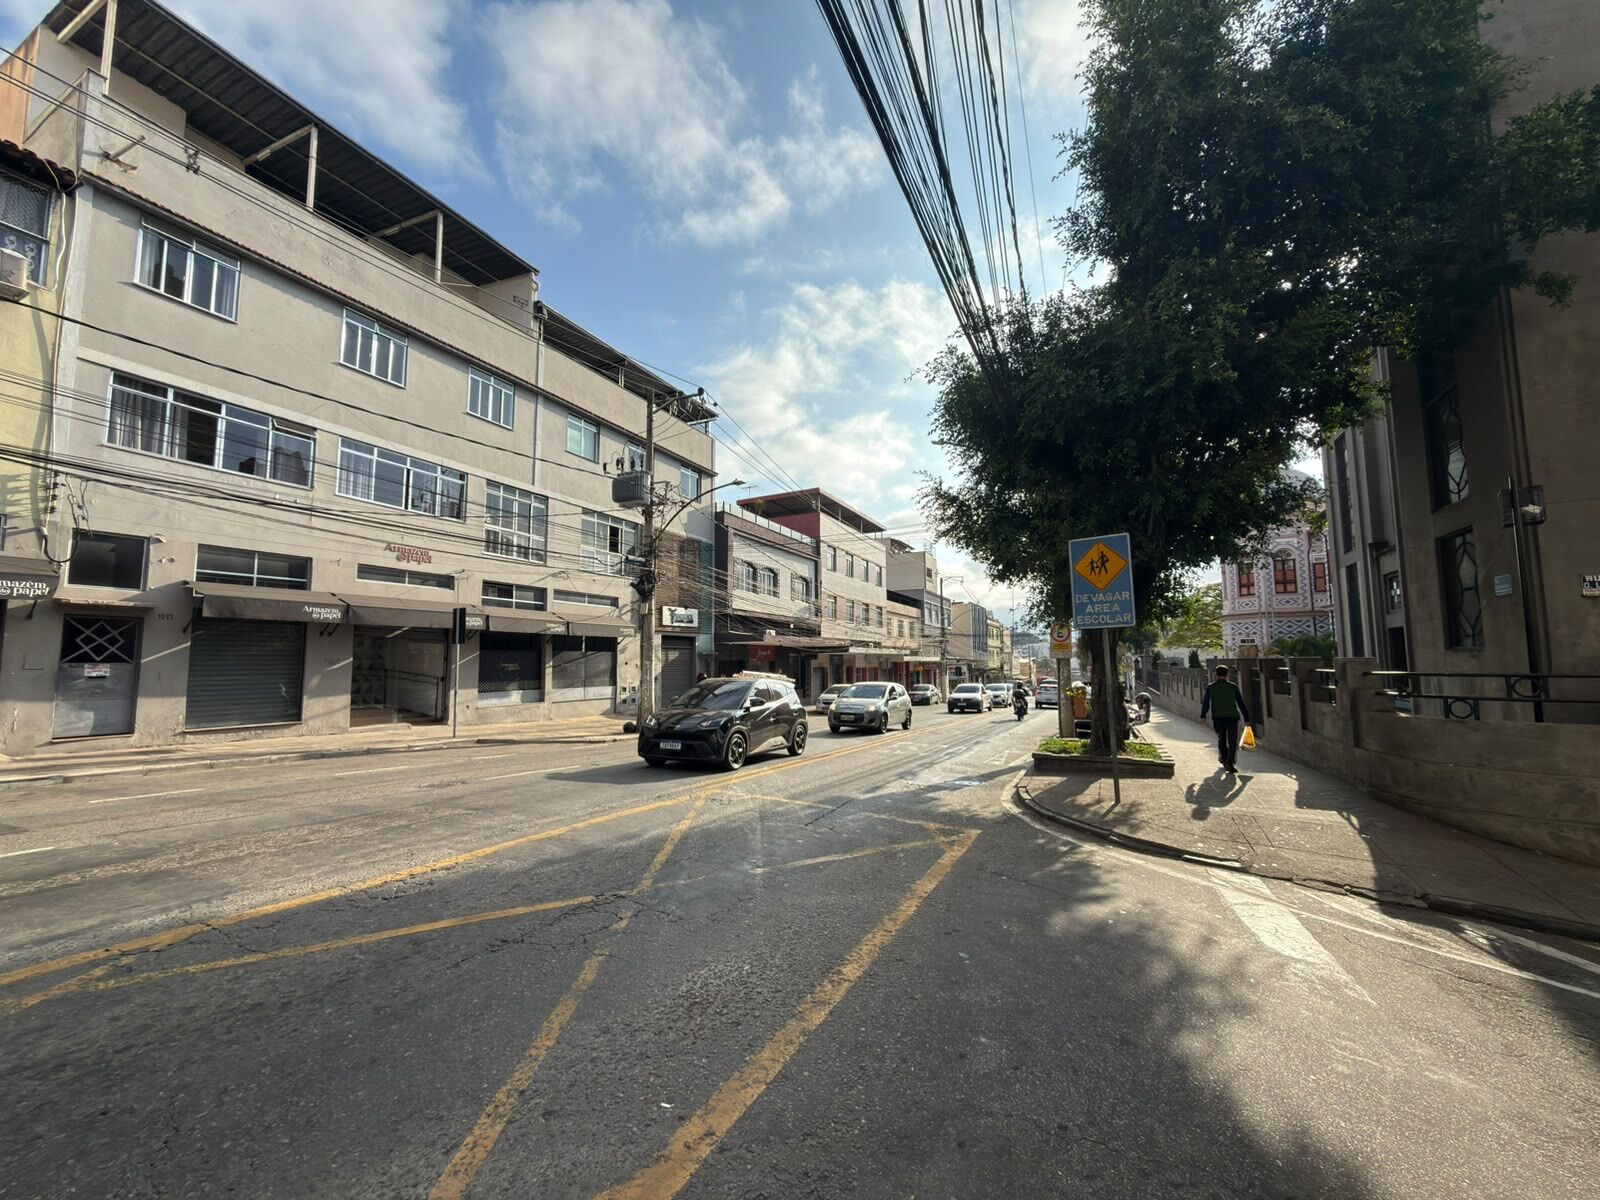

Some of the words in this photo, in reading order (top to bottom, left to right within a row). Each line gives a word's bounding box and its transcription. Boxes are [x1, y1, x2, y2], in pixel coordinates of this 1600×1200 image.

[13, 587, 50, 596] papel
[1075, 591, 1130, 603] DEVAGAR
[1077, 613, 1131, 624] ESCOLAR
